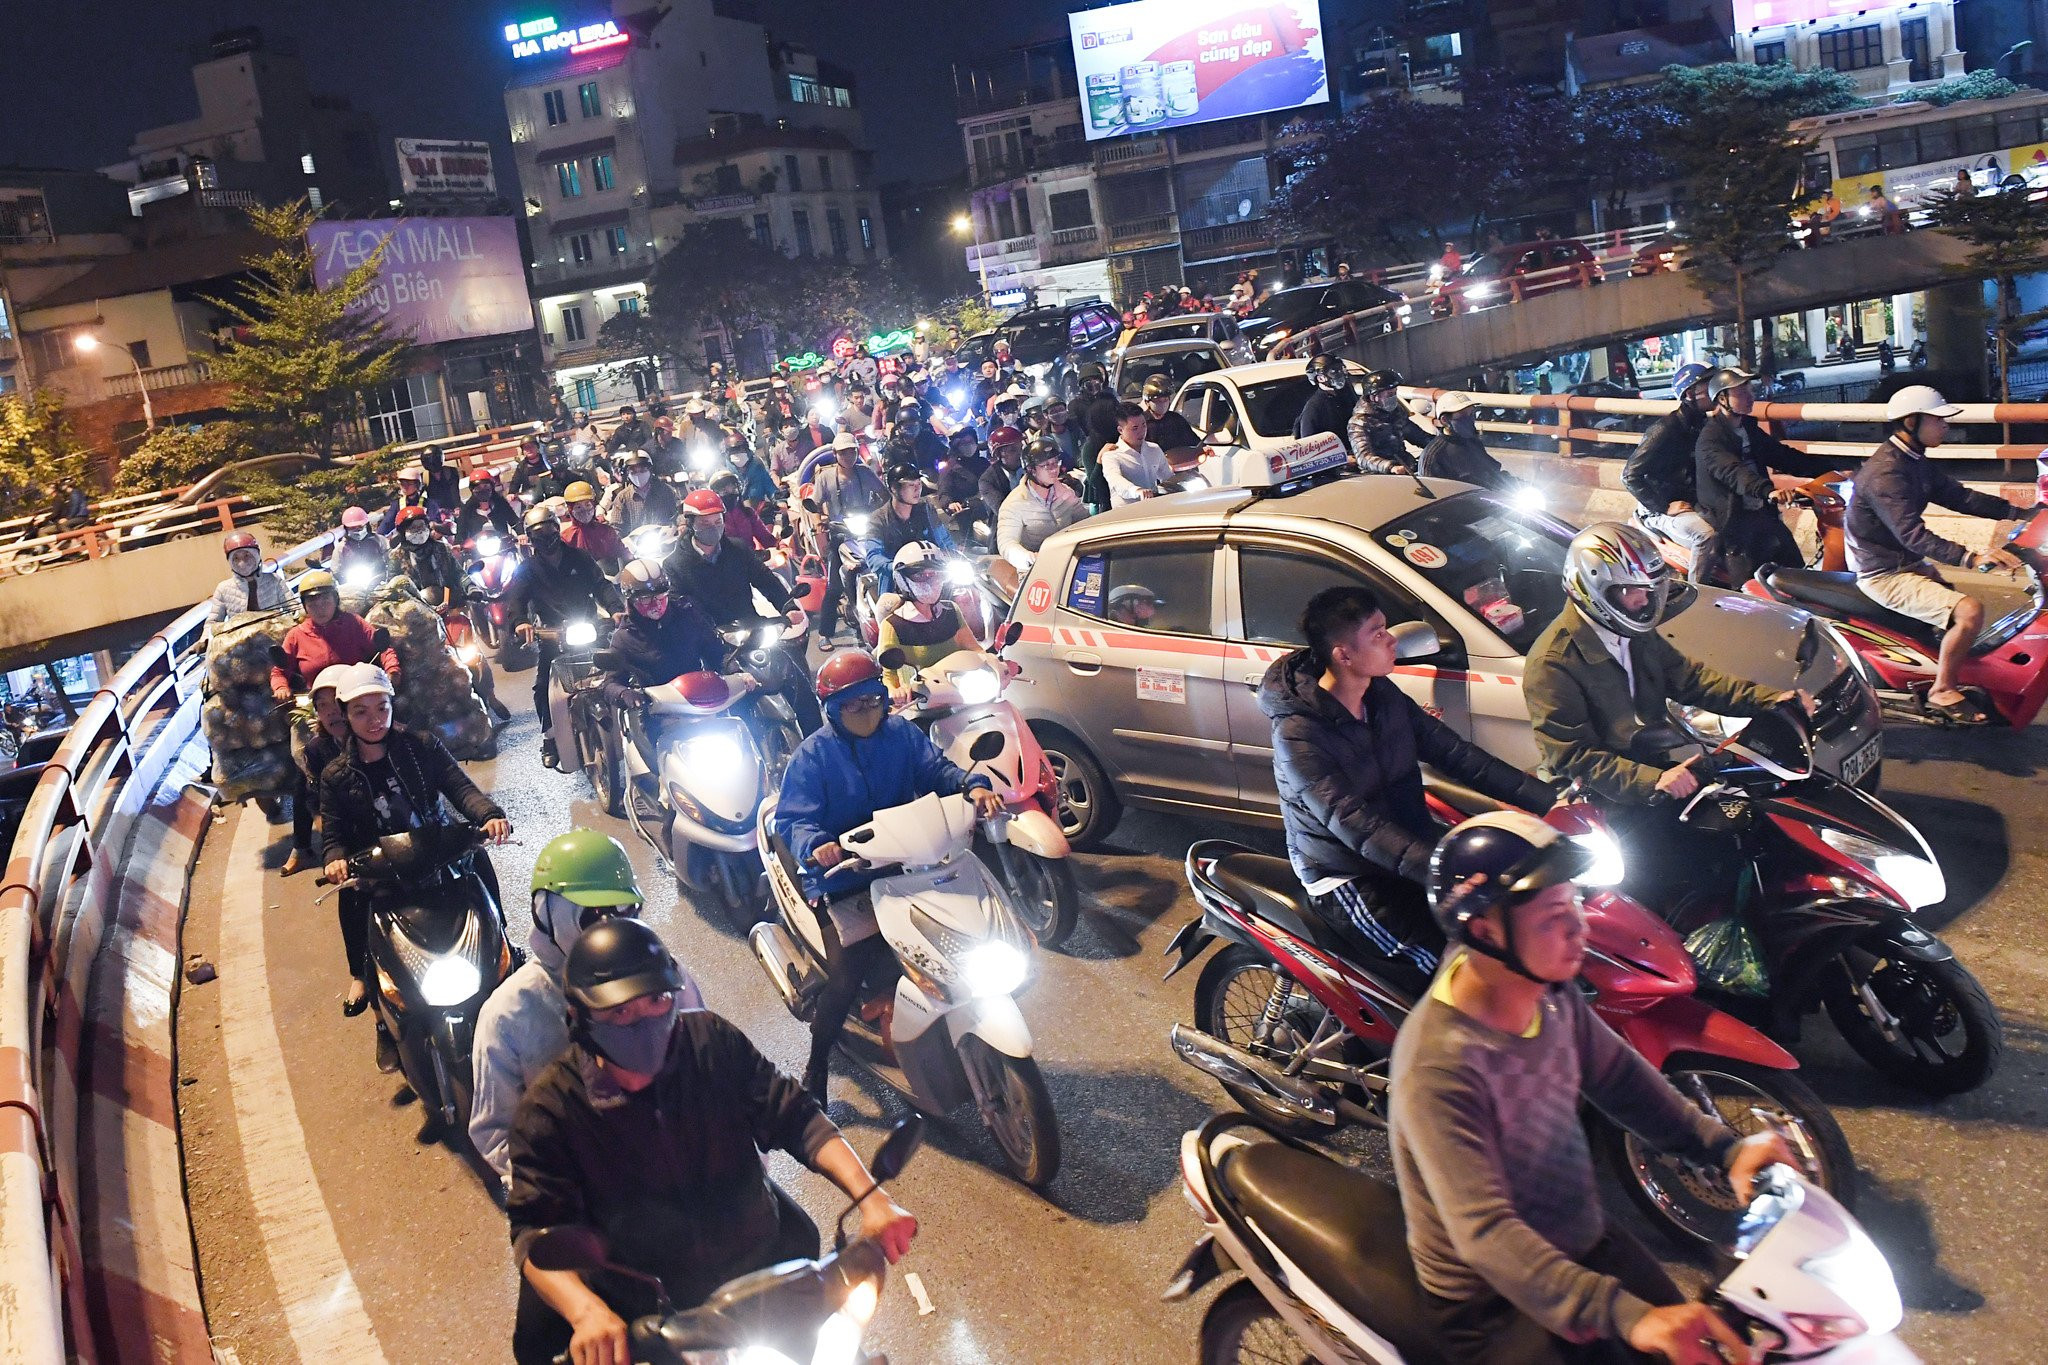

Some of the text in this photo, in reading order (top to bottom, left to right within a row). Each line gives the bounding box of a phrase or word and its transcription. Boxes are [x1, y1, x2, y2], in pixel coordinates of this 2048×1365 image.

[512, 40, 541, 58] HA
[1242, 39, 1273, 57] đẹp
[406, 226, 484, 264] MALL
[392, 270, 443, 304] Biên
[1410, 545, 1440, 564] 497
[1028, 586, 1049, 608] 497
[899, 991, 928, 1014] HONDA
